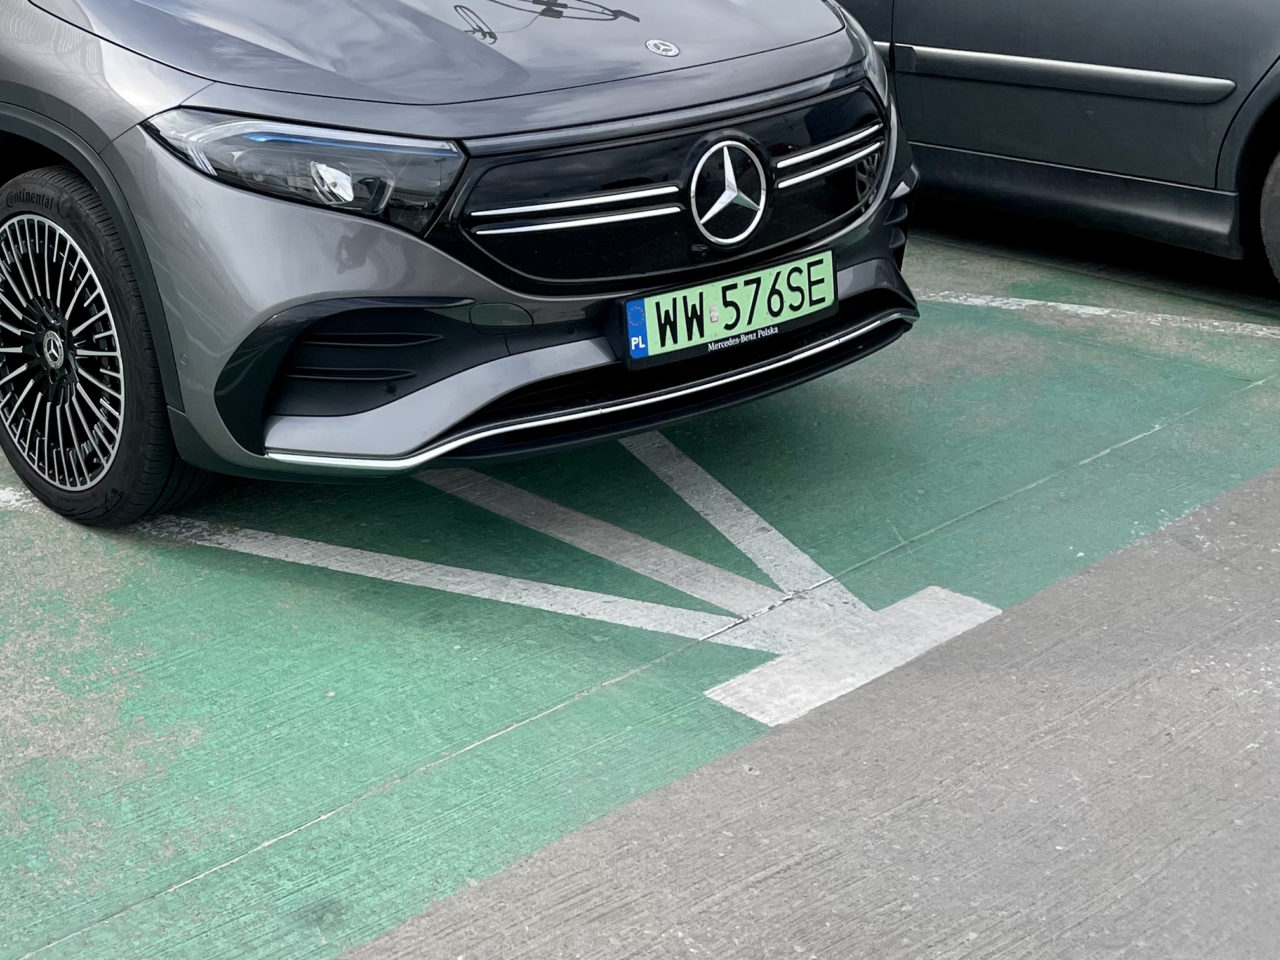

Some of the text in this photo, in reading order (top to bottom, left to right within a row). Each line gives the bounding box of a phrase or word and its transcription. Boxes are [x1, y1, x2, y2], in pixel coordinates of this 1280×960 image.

[655, 258, 826, 348] WW 576SE
[631, 335, 646, 350] PL
[707, 326, 779, 352] Mercedes-Benz Polska
